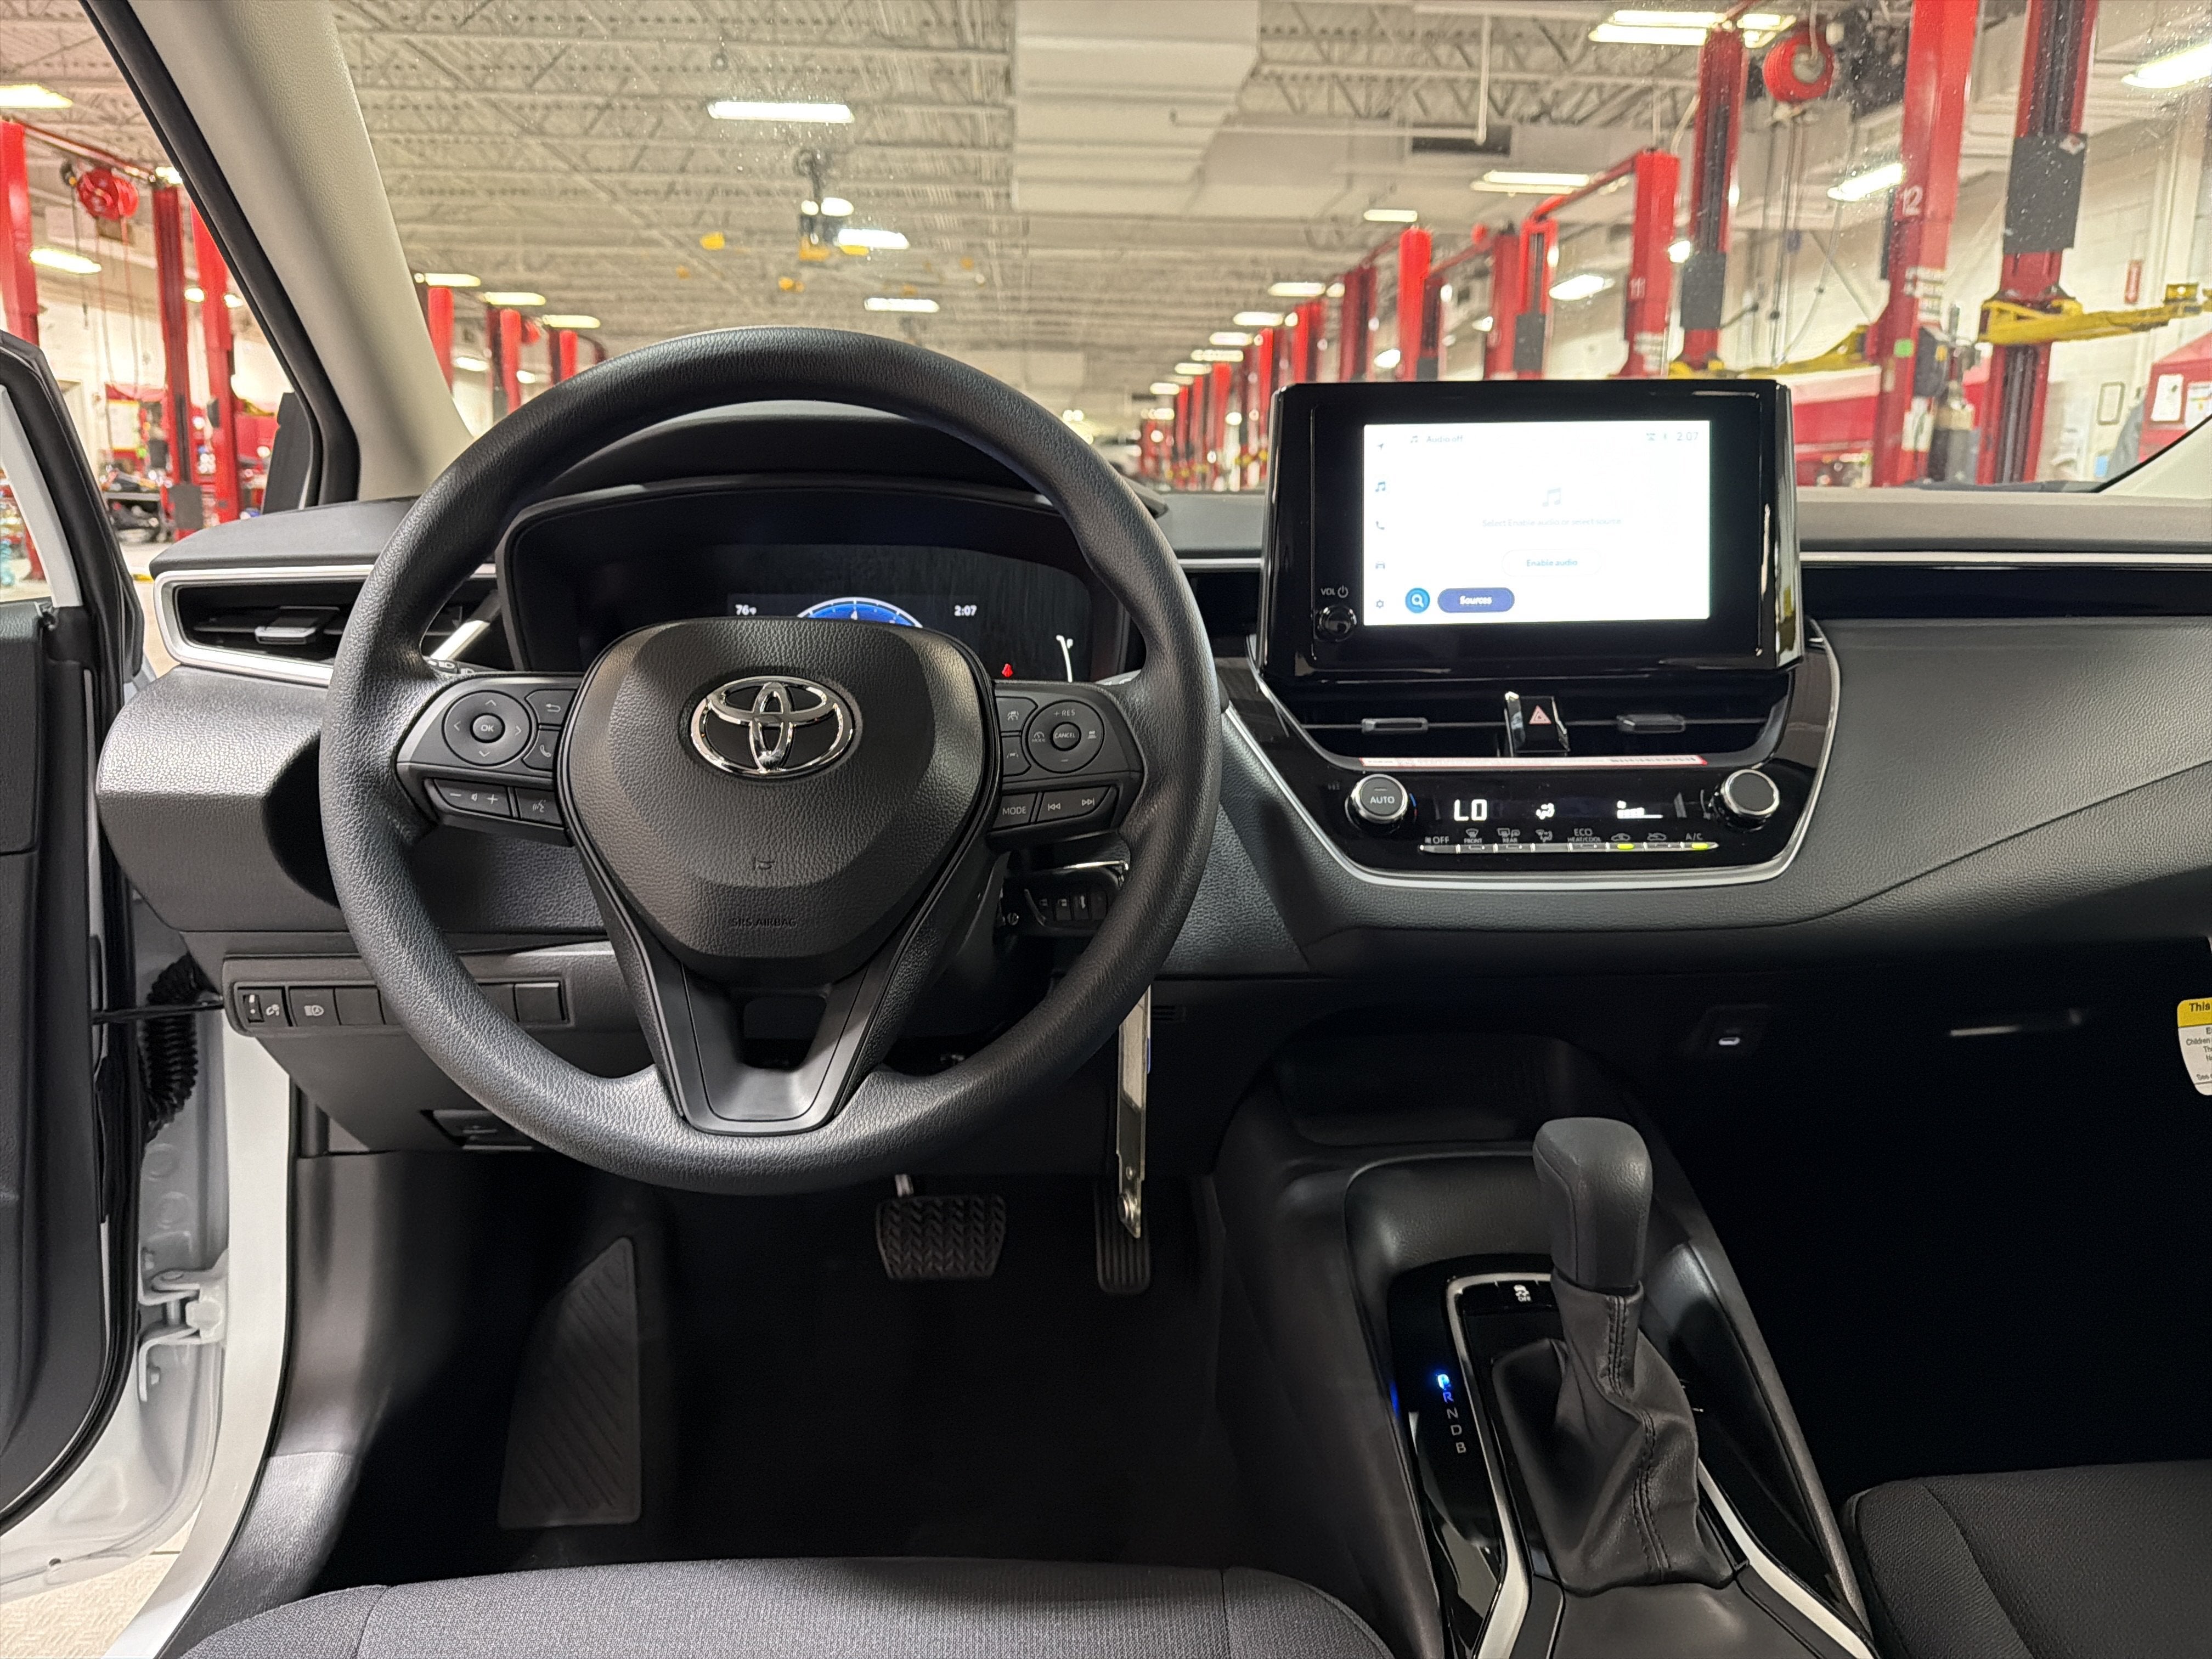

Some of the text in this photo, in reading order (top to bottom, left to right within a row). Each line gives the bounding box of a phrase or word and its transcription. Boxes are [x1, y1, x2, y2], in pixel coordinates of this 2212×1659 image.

[1900, 185, 1923, 216] 12
[1526, 558, 1578, 567] Enable audio
[1321, 588, 1336, 596] VOL
[953, 605, 977, 616] 2:07
[1062, 708, 1076, 717] RES
[481, 724, 494, 733] OK
[1370, 795, 1395, 804] AUTO
[1002, 806, 1026, 815] MODE
[1454, 799, 1487, 821] LO
[1573, 828, 1594, 837] ECO
[1685, 832, 1704, 841] A/C
[1432, 836, 1450, 844] OFF
[2189, 1001, 2211, 1012] This
[2186, 1037, 2211, 1046] Children
[1443, 1391, 1454, 1403] R
[1446, 1407, 1459, 1420] N
[1450, 1425, 1463, 1436] D
[1455, 1442, 1467, 1453] B
